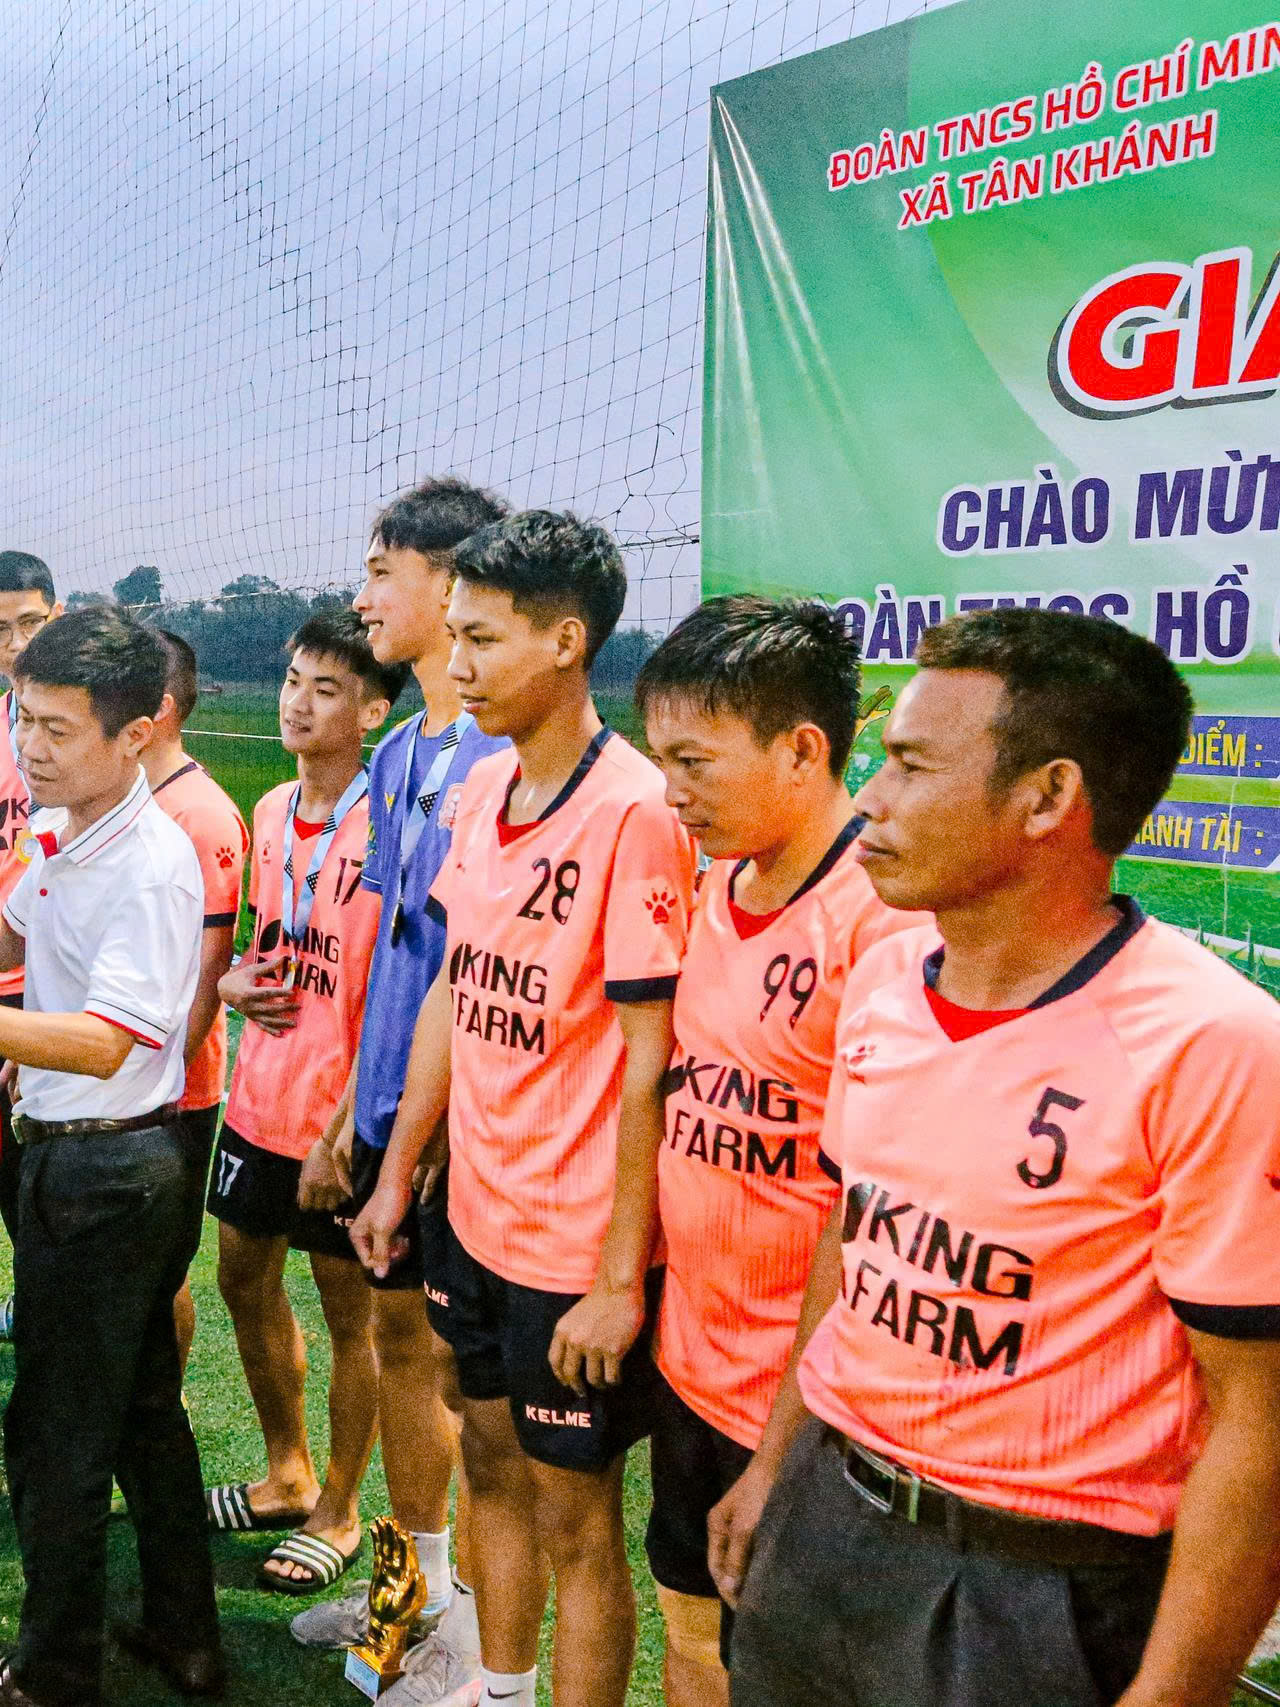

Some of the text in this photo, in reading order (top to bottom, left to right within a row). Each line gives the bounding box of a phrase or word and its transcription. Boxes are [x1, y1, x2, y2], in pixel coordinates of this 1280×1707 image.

[829, 130, 926, 188] ĐOÀN
[937, 104, 1033, 157] TNCS
[1044, 64, 1103, 122] HỒ
[1115, 43, 1189, 109] CHÍ
[900, 114, 1216, 227] XÃ TÂN KHÁNH
[941, 469, 1110, 552] CHÀO
[832, 564, 1250, 659] OÀN HỒ
[1135, 814, 1193, 849] ANH
[1200, 812, 1242, 853] TÀI
[517, 857, 580, 926] 28
[461, 943, 547, 1006] KING
[760, 953, 818, 1030] 99
[456, 991, 545, 1055] FARM
[683, 1055, 799, 1124] KING
[217, 1150, 244, 1196] 17
[670, 1109, 797, 1179] FARM
[1016, 1087, 1086, 1189] 5
[867, 1190, 1034, 1302] KING
[850, 1259, 1025, 1377] FARM
[525, 1403, 592, 1428] KELME
